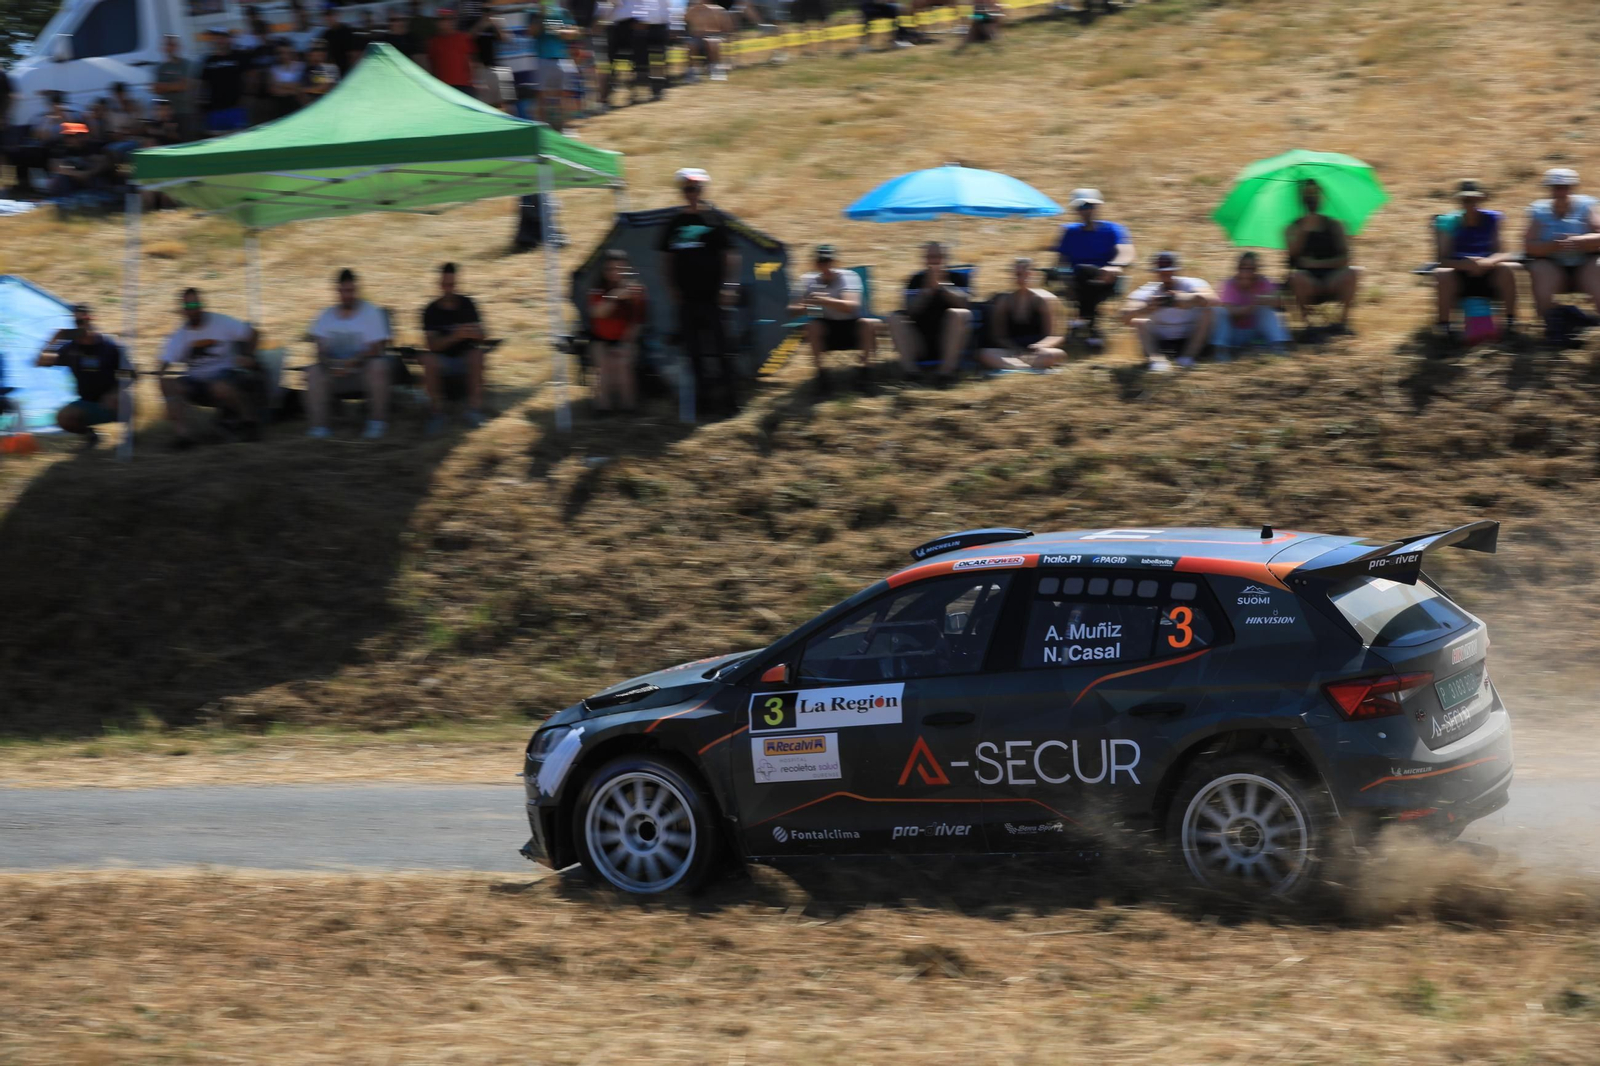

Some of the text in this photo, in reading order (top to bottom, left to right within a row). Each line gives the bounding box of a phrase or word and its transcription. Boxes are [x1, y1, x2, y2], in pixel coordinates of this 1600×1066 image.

[925, 540, 961, 553] MICHELIN
[988, 557, 1022, 565] POWER
[1100, 556, 1127, 564] PAGID
[1237, 597, 1271, 605] SUOMI
[1245, 616, 1295, 624] HIKVISION
[1044, 622, 1122, 641] A. Muñiz
[1167, 606, 1193, 648] 3
[1043, 642, 1120, 662] N. Casal
[763, 694, 898, 726] 3 La Región
[776, 740, 814, 752] Recalvi
[780, 761, 838, 773] recoletas salud
[1403, 766, 1432, 775] MICHELIN
[791, 829, 861, 840] Fontalclima
